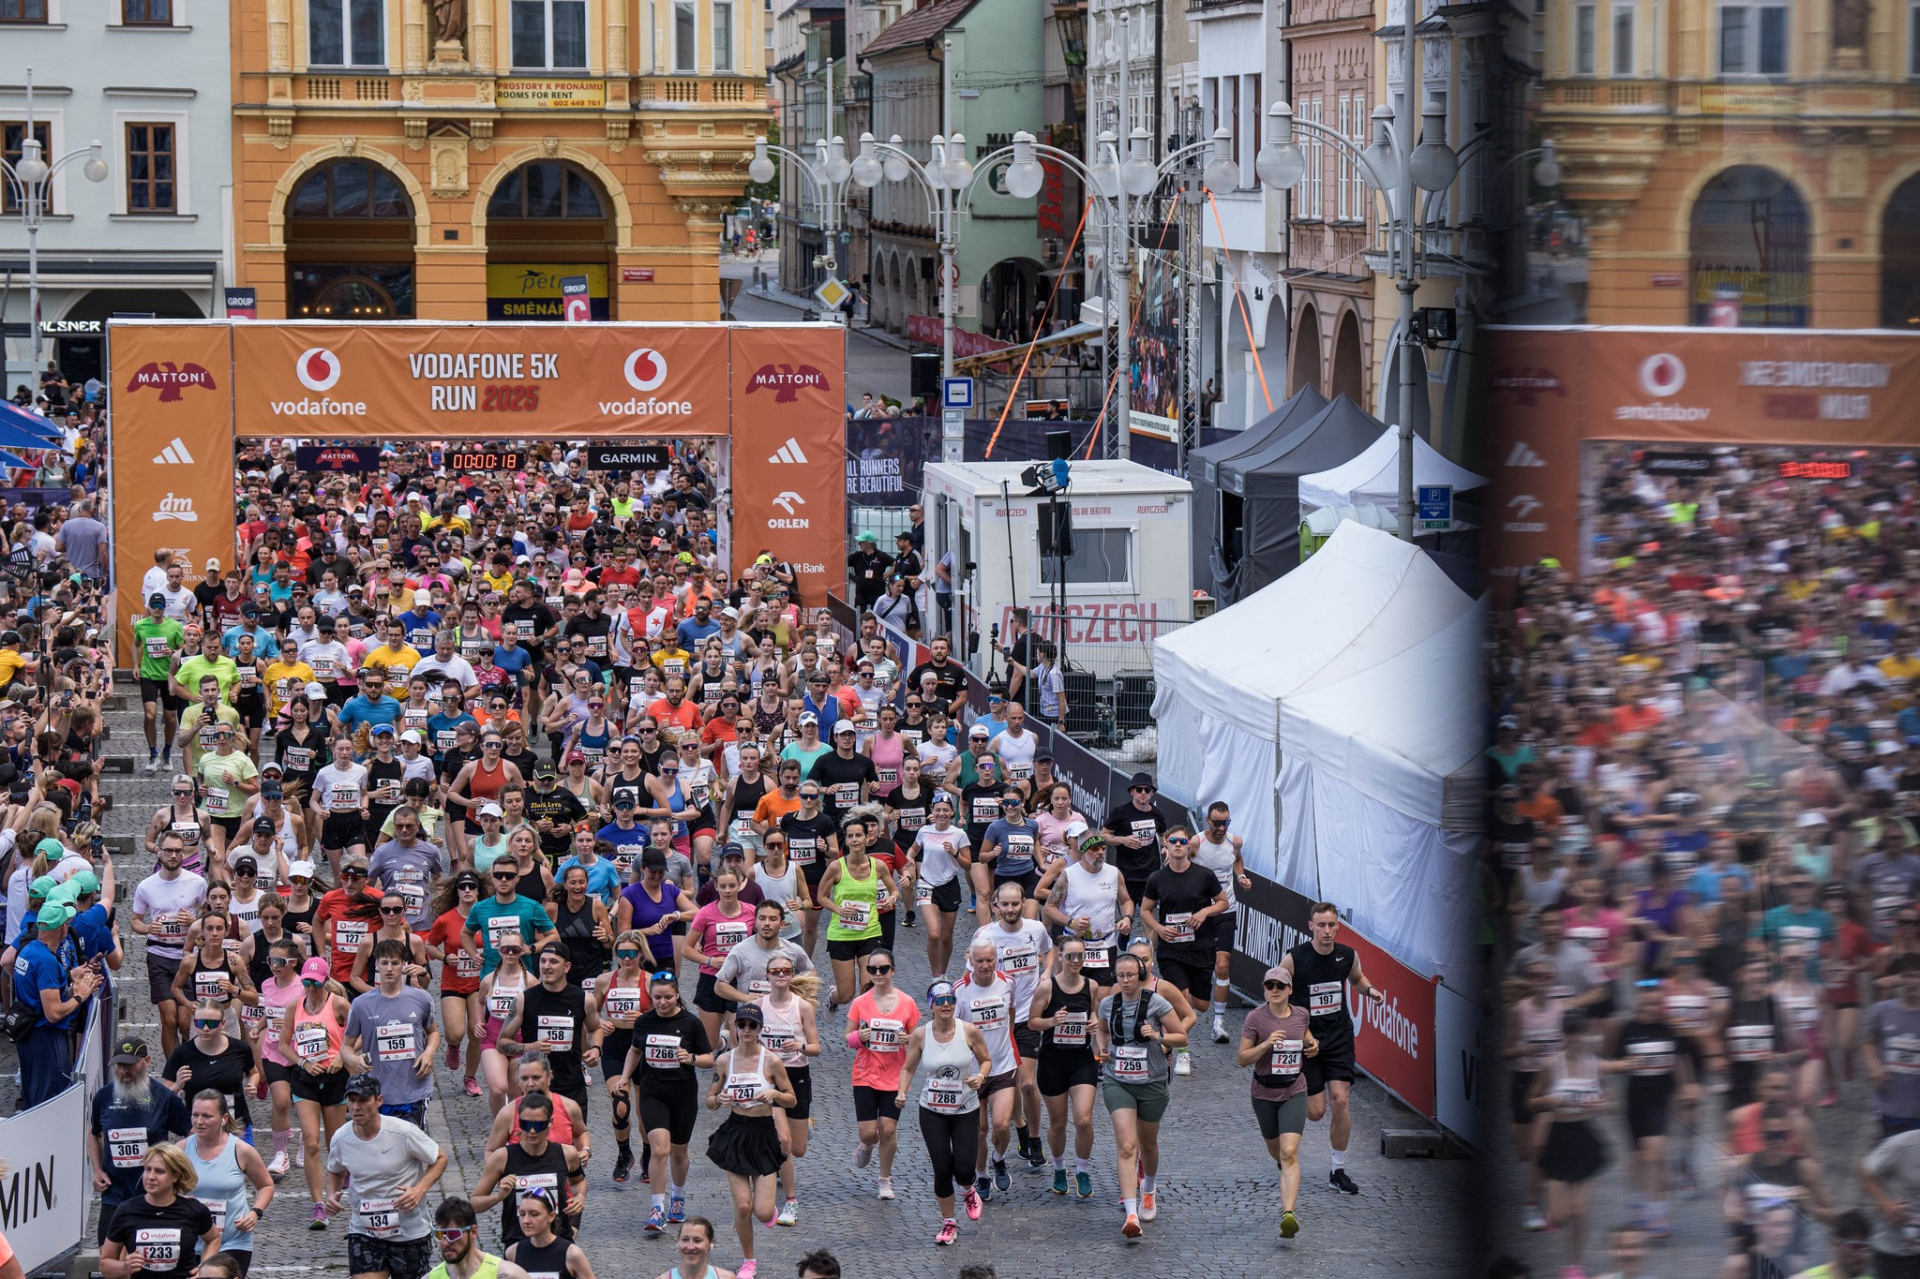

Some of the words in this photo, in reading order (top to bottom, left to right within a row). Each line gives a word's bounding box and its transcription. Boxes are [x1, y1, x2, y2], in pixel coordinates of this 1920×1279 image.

[555, 81, 602, 90] PRONÁJMU
[564, 285, 586, 294] GROUP
[227, 297, 254, 306] GROUP
[503, 302, 566, 316] SMĚNÁR
[568, 300, 587, 322] C
[40, 320, 100, 333] ILSNER
[409, 354, 524, 379] VODAFONE
[530, 354, 559, 379] 5K
[138, 372, 206, 383] MATTONI
[756, 374, 820, 384] MATTONI
[431, 385, 476, 411] RUN
[482, 385, 540, 411] 2025
[270, 398, 366, 415] vodafone
[599, 397, 692, 415] vodafone
[600, 454, 656, 464] GARMIN
[860, 458, 900, 476] RUNNERS
[860, 476, 904, 493] BEAUTIFUL
[160, 493, 192, 511] dm
[768, 518, 809, 529] ORLEN
[803, 563, 825, 573] Bank
[722, 935, 742, 943] F230
[1245, 907, 1282, 968] RUNNERS
[1013, 958, 1028, 968] 132
[1318, 994, 1334, 1006] 197
[614, 1002, 634, 1011] F267
[980, 1009, 997, 1020] 133
[1060, 1024, 1081, 1035] F498
[1366, 990, 1418, 1059] vodafone
[546, 1031, 565, 1041] 158
[303, 1043, 320, 1054] F127
[387, 1039, 405, 1050] 159
[651, 1048, 674, 1058] F266
[1277, 1053, 1297, 1065] F234
[1120, 1060, 1142, 1071] F259
[733, 1088, 754, 1099] F247
[933, 1092, 956, 1104] F288
[118, 1144, 139, 1156] 306
[369, 1215, 388, 1227] 134
[143, 1247, 172, 1259] F233
